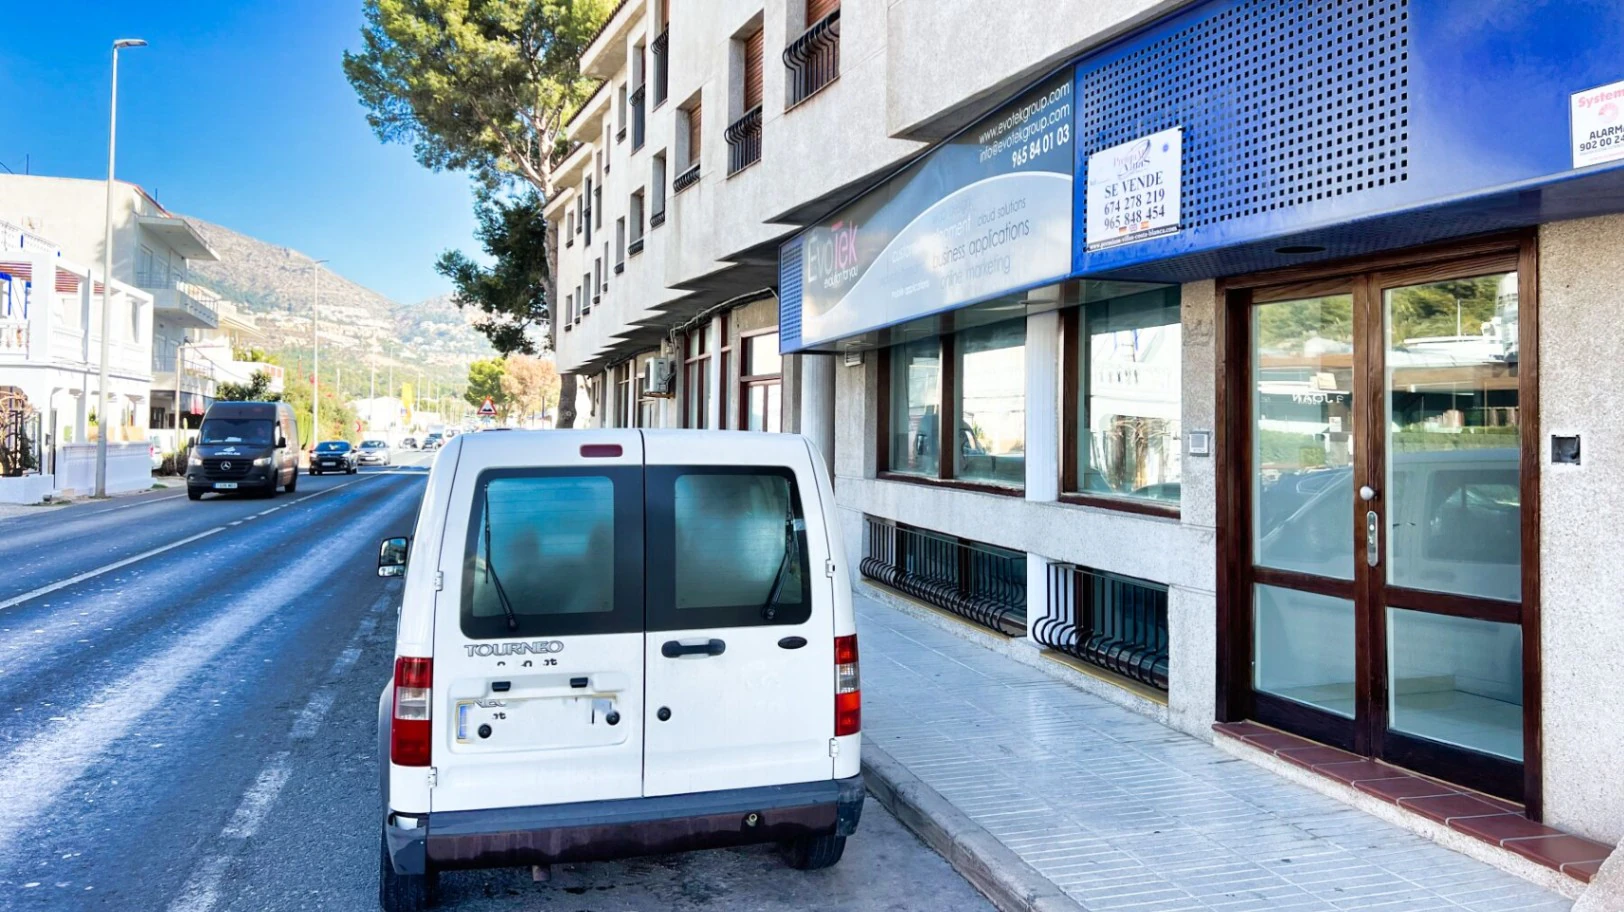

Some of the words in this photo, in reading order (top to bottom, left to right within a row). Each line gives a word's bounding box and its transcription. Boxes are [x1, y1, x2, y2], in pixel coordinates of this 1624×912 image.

[979, 83, 1070, 144] www.evotekgroup.com
[979, 103, 1070, 163] info@evotekgroup.com
[1012, 145, 1028, 168] 965
[1029, 138, 1041, 160] 84
[1042, 132, 1054, 153] 01
[1057, 123, 1070, 146] 03
[1579, 140, 1598, 152] 902
[1599, 136, 1612, 147] 00
[1589, 124, 1624, 141] ALARM
[1104, 183, 1118, 199] SE
[1122, 170, 1164, 193] VENDE
[997, 197, 1027, 219] solutions
[1104, 200, 1120, 216] 674
[1124, 194, 1142, 210] 278
[1146, 188, 1165, 205] 219
[1104, 215, 1120, 232] 965
[1124, 209, 1142, 226] 848
[1146, 204, 1165, 221] 454
[932, 244, 966, 269] business
[968, 219, 1031, 258] applications
[464, 639, 565, 658] TOURNEO
